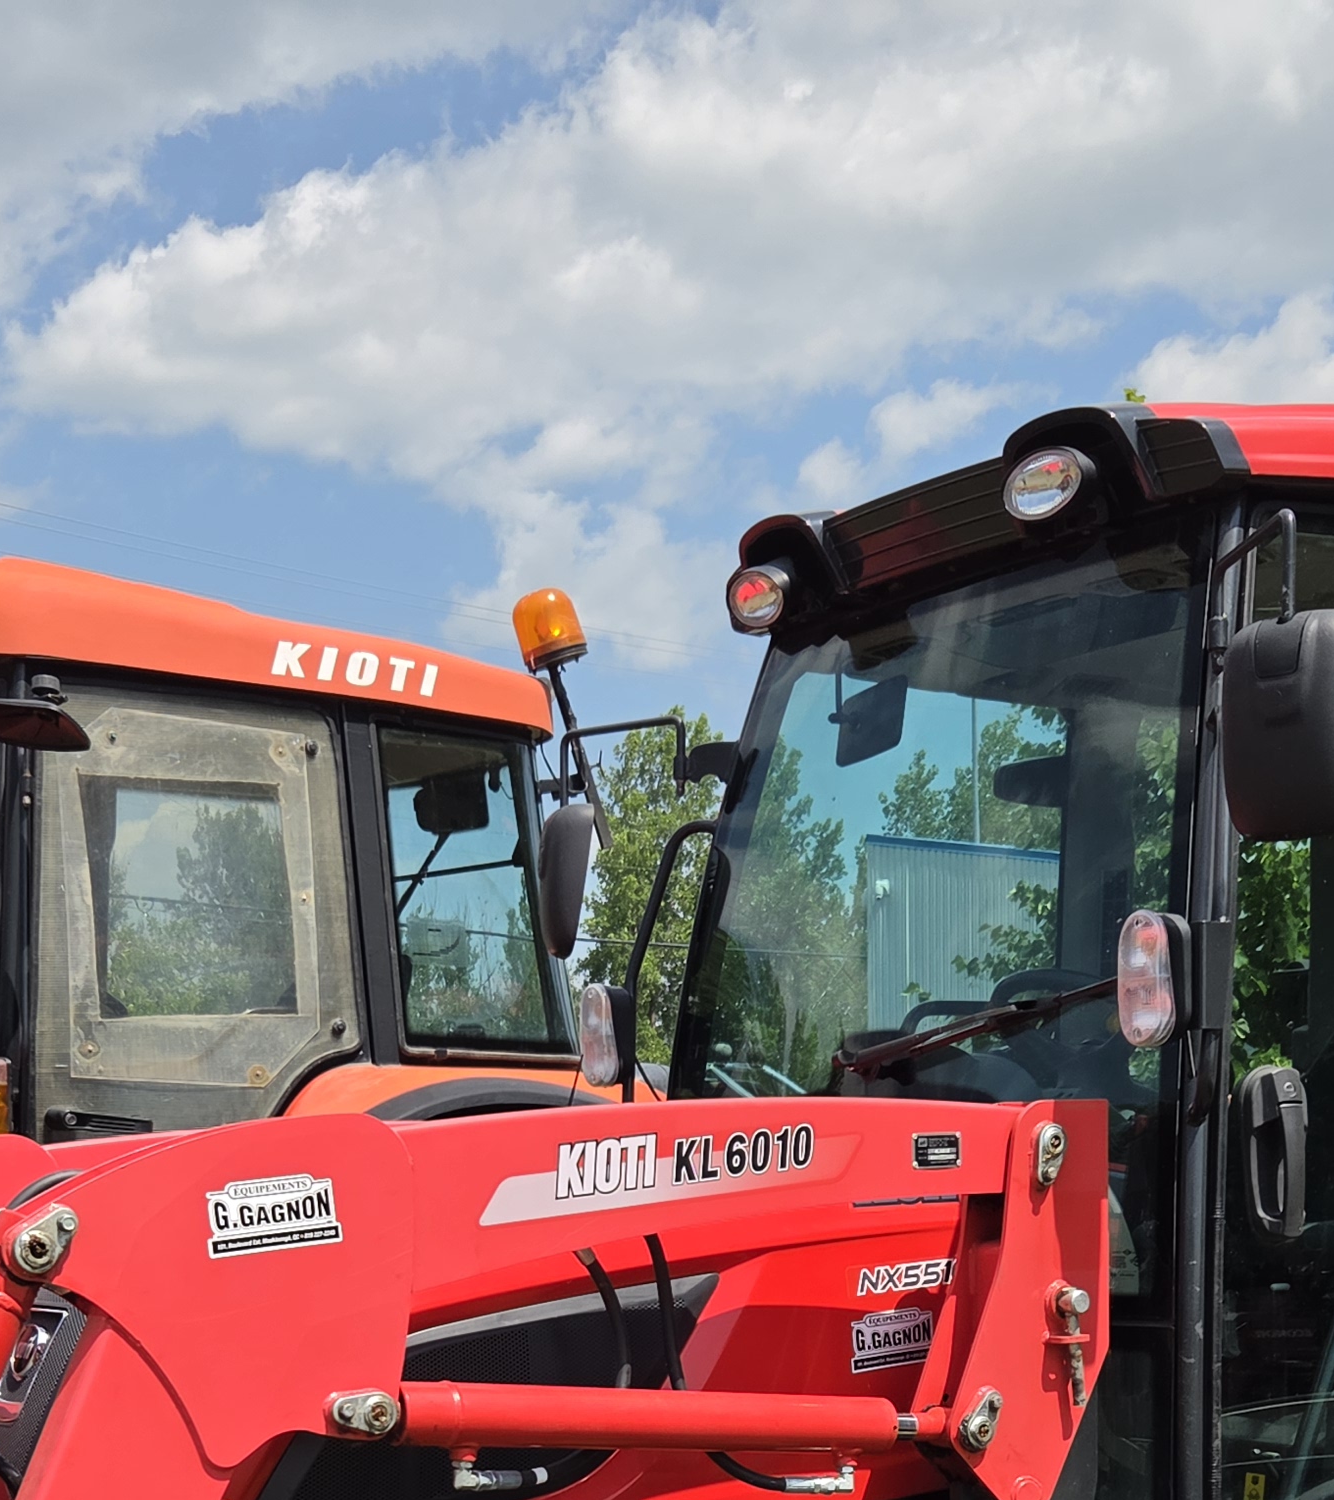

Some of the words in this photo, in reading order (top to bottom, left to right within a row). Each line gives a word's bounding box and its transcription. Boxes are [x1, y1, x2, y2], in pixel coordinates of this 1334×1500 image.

[270, 640, 439, 698] KIOTI
[555, 1132, 658, 1200] KIOTI
[213, 1187, 331, 1231] G.GAGNON
[857, 1258, 956, 1296] NX551
[855, 1318, 932, 1352] G.GAGNON
